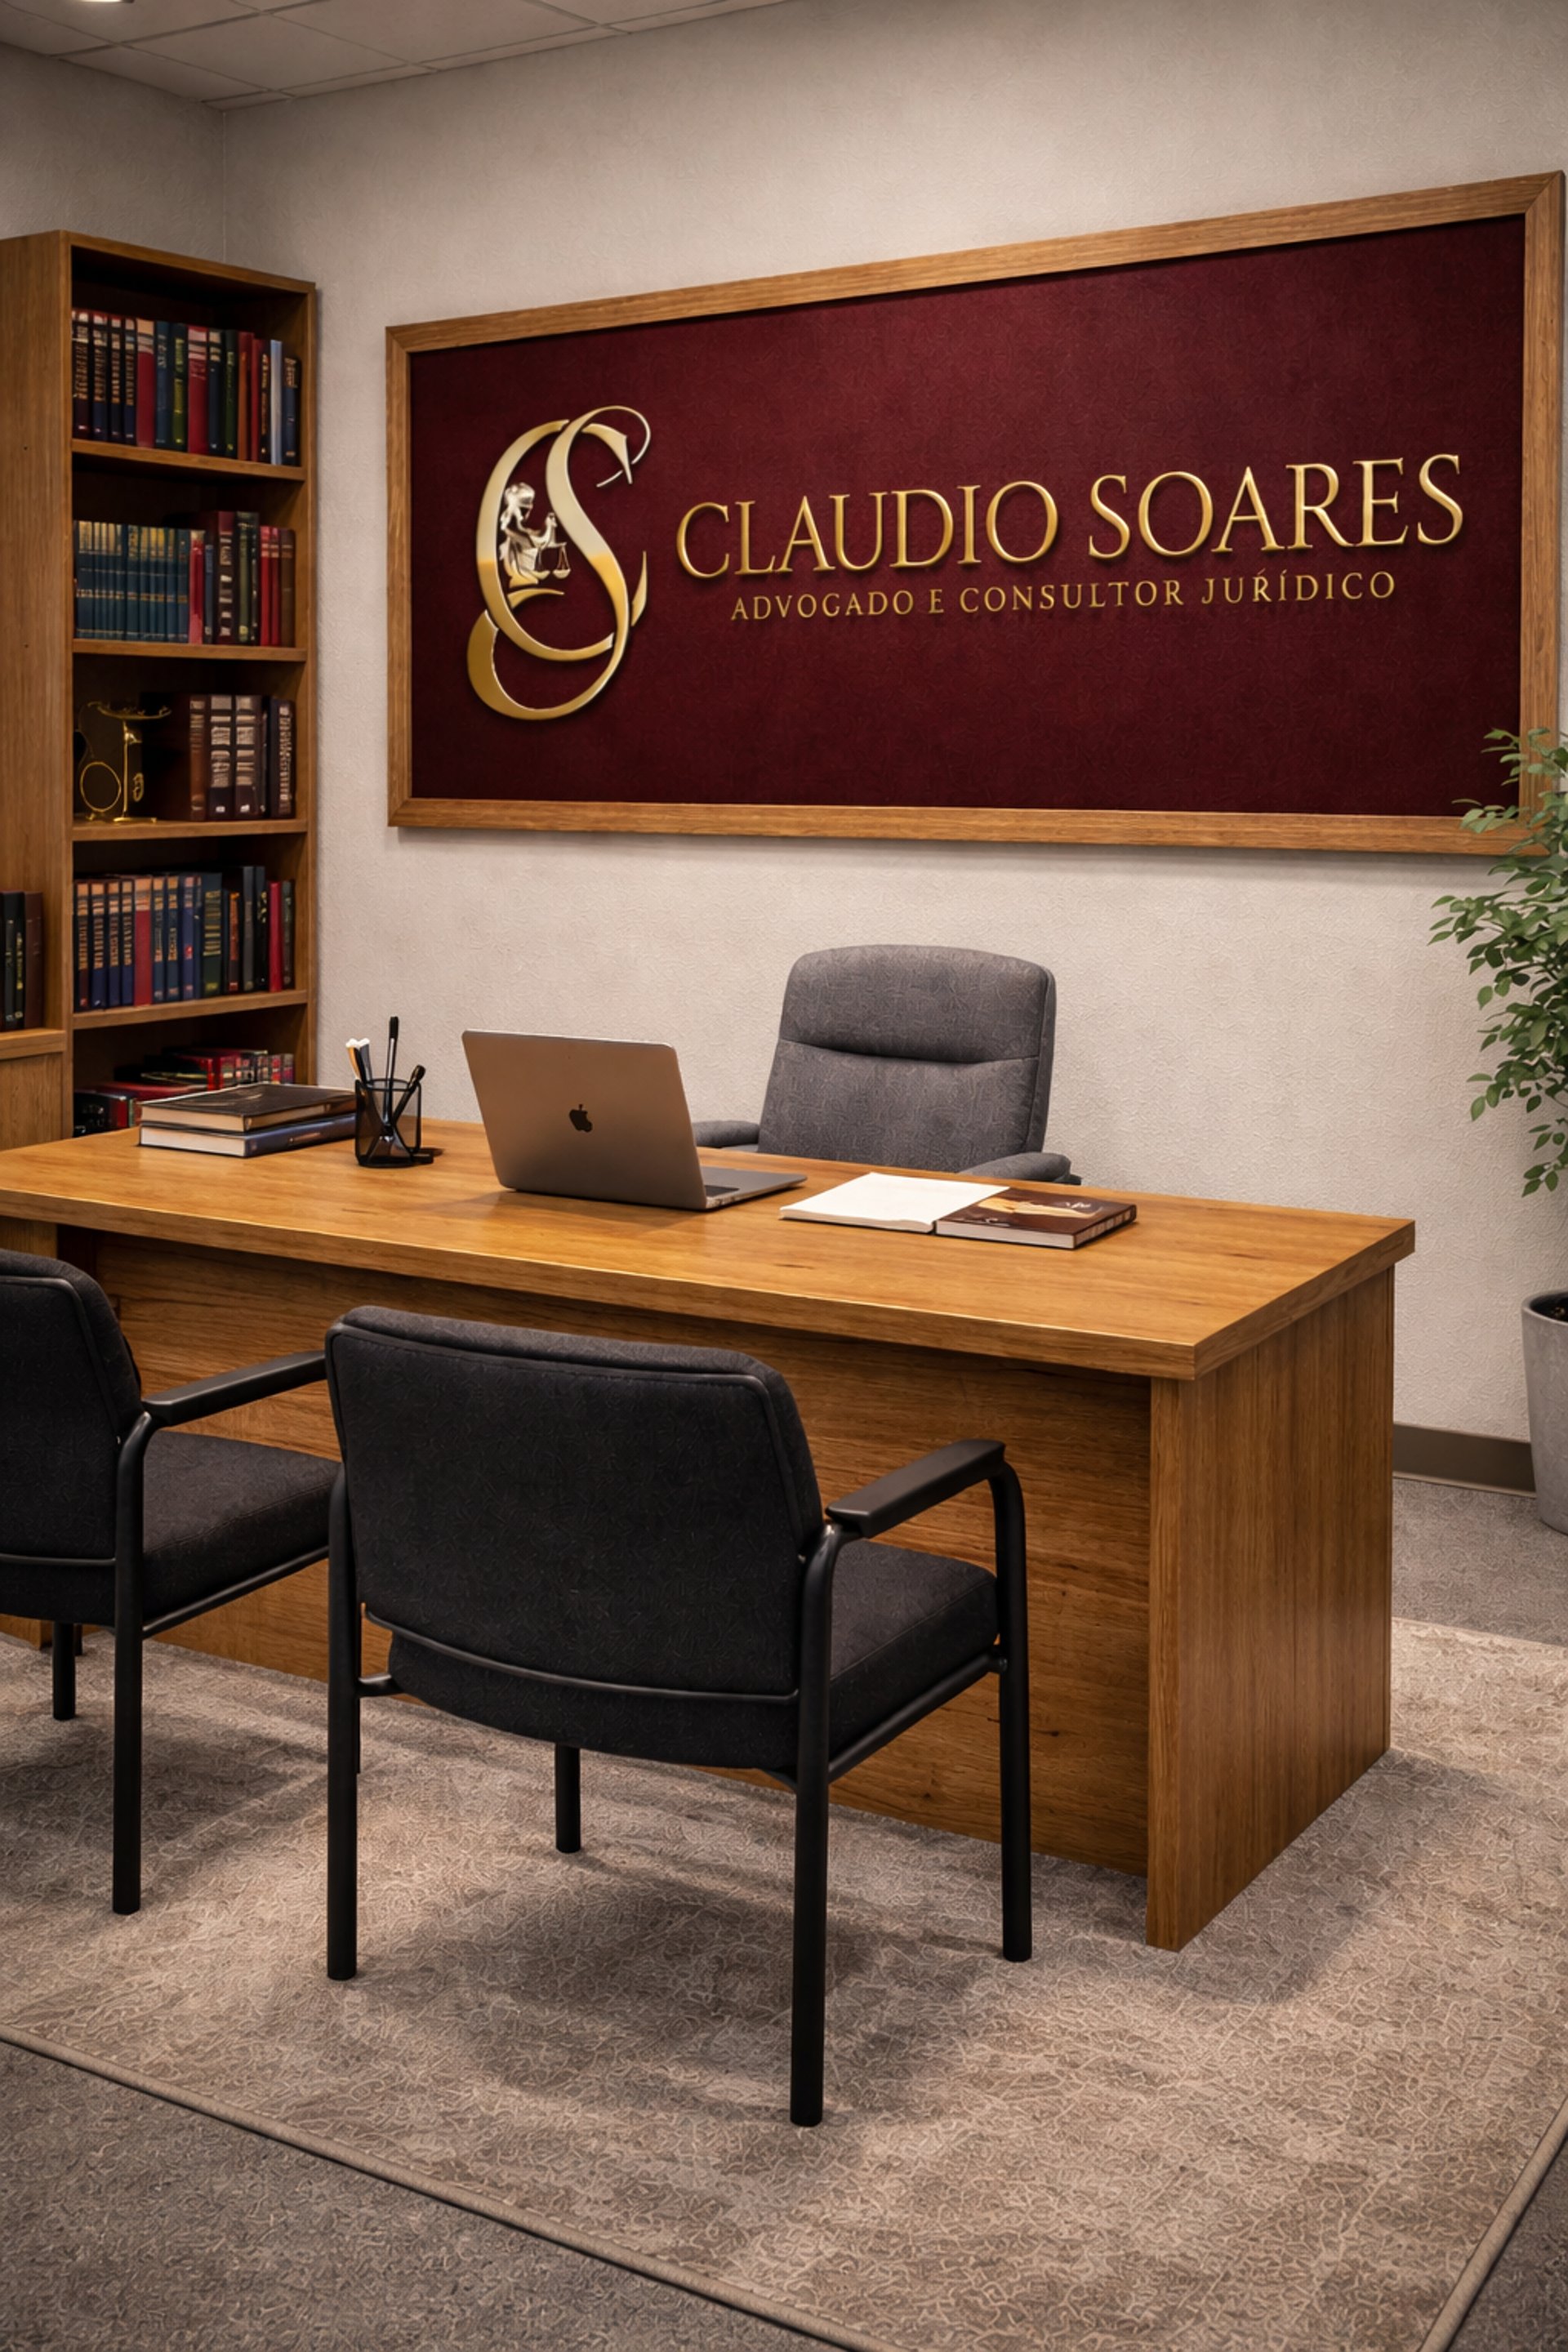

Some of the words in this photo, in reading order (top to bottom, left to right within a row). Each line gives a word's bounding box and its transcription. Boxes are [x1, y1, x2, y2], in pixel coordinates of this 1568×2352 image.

[676, 480, 1059, 579] CLAUDIO
[1088, 453, 1463, 559] SOARES
[731, 590, 914, 621] ADVOGADO
[929, 588, 945, 613] E
[960, 580, 1184, 612] CONSULTOR
